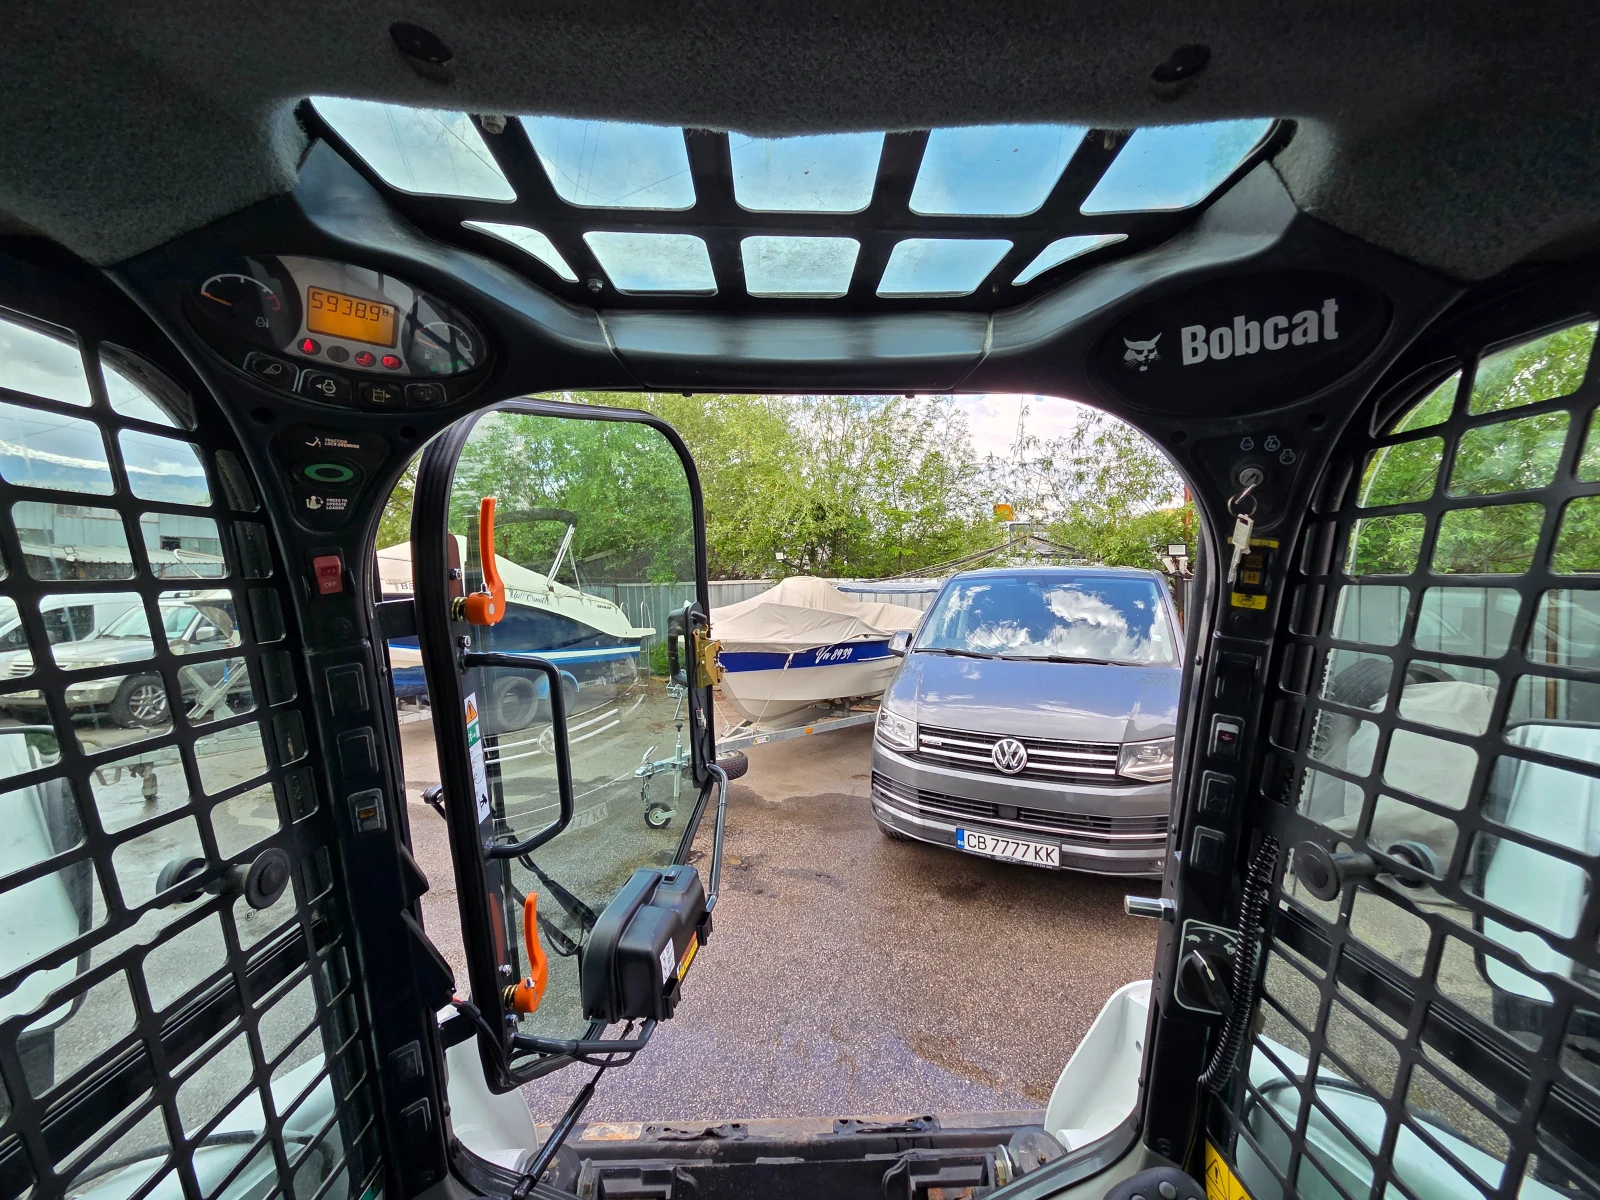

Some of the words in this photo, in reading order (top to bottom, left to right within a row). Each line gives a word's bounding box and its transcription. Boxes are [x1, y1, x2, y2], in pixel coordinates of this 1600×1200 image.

[311, 291, 381, 322] 5938.9
[1181, 298, 1338, 366] Bobcat
[967, 833, 987, 851] CB
[990, 838, 1031, 858] 7777
[1034, 845, 1056, 863] KK
